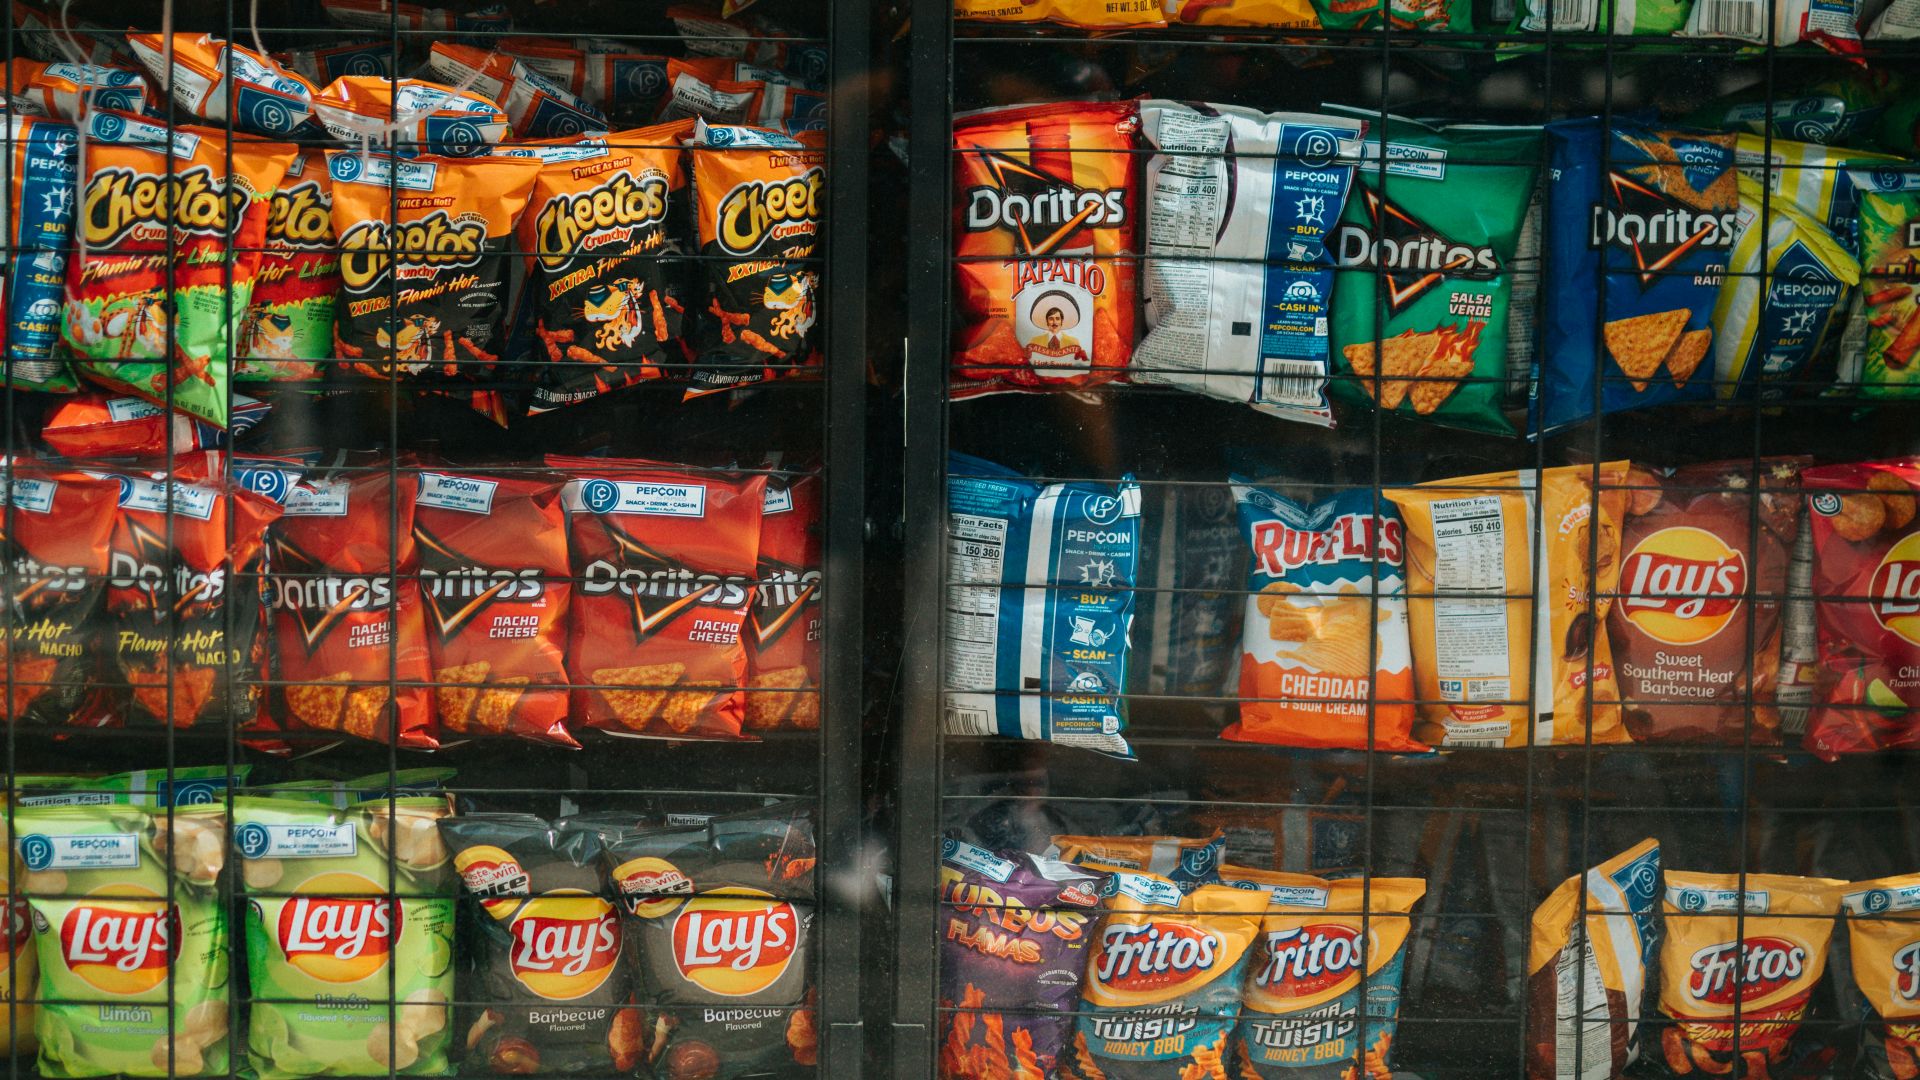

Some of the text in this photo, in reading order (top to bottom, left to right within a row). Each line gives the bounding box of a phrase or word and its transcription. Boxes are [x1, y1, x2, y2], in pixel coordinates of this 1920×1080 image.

[998, 7, 1024, 17] SNACKS
[1107, 2, 1119, 13] NET
[1134, 1, 1140, 12] 3
[571, 156, 633, 180] TWICE As Hot!
[1186, 186, 1215, 195] 150 400
[84, 170, 241, 242] Cheetos
[414, 196, 453, 208] As Hot!
[969, 186, 1126, 228] Doritos
[43, 222, 67, 232] BUY
[539, 180, 663, 266] Cheetos
[771, 222, 817, 239] Crunchy
[1297, 225, 1319, 235] BUY
[583, 228, 632, 250] Crunchy
[1340, 228, 1498, 271] Doritos
[549, 265, 595, 301] XXTRA
[1279, 303, 1306, 312] CASH
[1451, 293, 1492, 305] SALSA
[1450, 304, 1492, 317] VERDE
[1779, 338, 1805, 347] BUY
[1434, 499, 1497, 510] Nutrition Facts
[978, 519, 1003, 530] Facts
[1437, 521, 1501, 537] Calories 150 410
[965, 545, 1000, 558] 150 380
[1254, 517, 1404, 574] RUFFLES
[584, 560, 747, 606] Doritos
[1628, 554, 1740, 620] Lay's
[1081, 594, 1108, 605] BUY
[494, 616, 539, 626] NACHO
[693, 620, 739, 632] NACHO
[489, 626, 539, 639] CHEESE
[688, 631, 738, 644] CHEESE
[40, 641, 83, 657] NACHO
[1073, 649, 1107, 661] SCAN
[1655, 651, 1703, 668] Sweet
[1624, 663, 1735, 684] Southern Heat
[1281, 674, 1371, 699] CHEDDAR
[1641, 680, 1716, 698] Barbecue
[1062, 696, 1095, 705] CASH
[1293, 701, 1323, 713] SOUR
[1326, 702, 1367, 718] CREAM
[656, 872, 678, 887] win
[941, 867, 1090, 941] TURBOS
[1062, 889, 1096, 906] Sabritas
[286, 899, 393, 961] Lay's
[684, 905, 789, 972] Lay's
[69, 908, 177, 972] Lay's
[517, 915, 617, 977] Lay's
[947, 919, 1041, 965] FLAMAS
[1098, 923, 1218, 982] Fritos
[1256, 927, 1364, 985] Fritos
[99, 1004, 152, 1022] Limón
[529, 1009, 606, 1024] Barbecue
[704, 1009, 782, 1024] Barbecue
[550, 1023, 586, 1033] Flavored
[726, 1021, 762, 1031] Flavored
[1104, 1035, 1186, 1056] HONEY BBQ
[1265, 1040, 1346, 1062] HONEY BBQ
